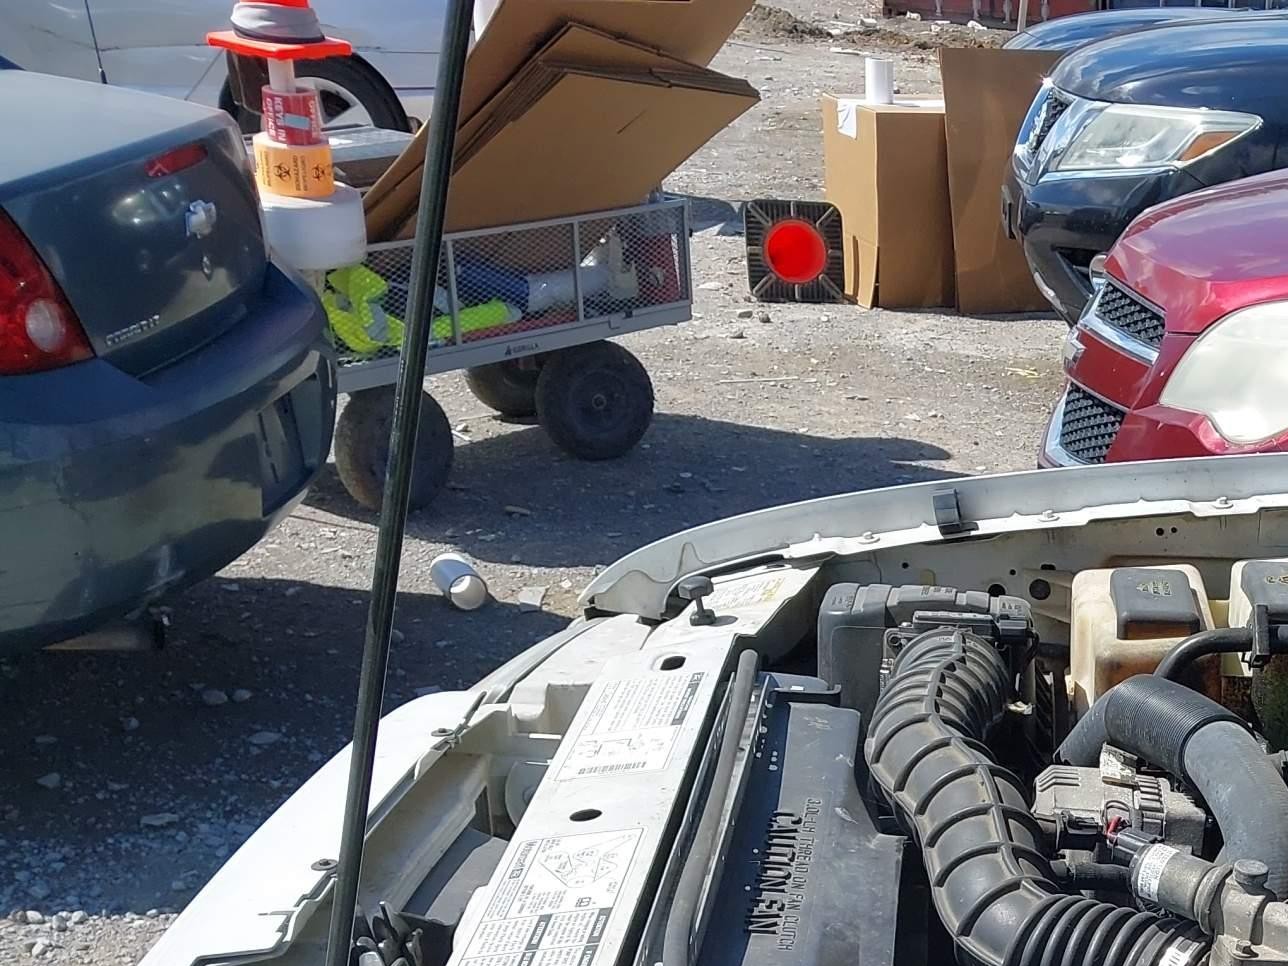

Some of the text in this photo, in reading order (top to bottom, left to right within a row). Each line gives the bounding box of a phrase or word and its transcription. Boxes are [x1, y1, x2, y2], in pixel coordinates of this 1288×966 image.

[265, 98, 276, 138] OFFICE
[274, 97, 287, 141] KEYS IN
[747, 810, 803, 936] CAUTION FAN
[795, 836, 815, 873] THREAD
[786, 893, 804, 911] FAN
[791, 876, 807, 891] ON
[778, 915, 799, 951] CLUTCH
